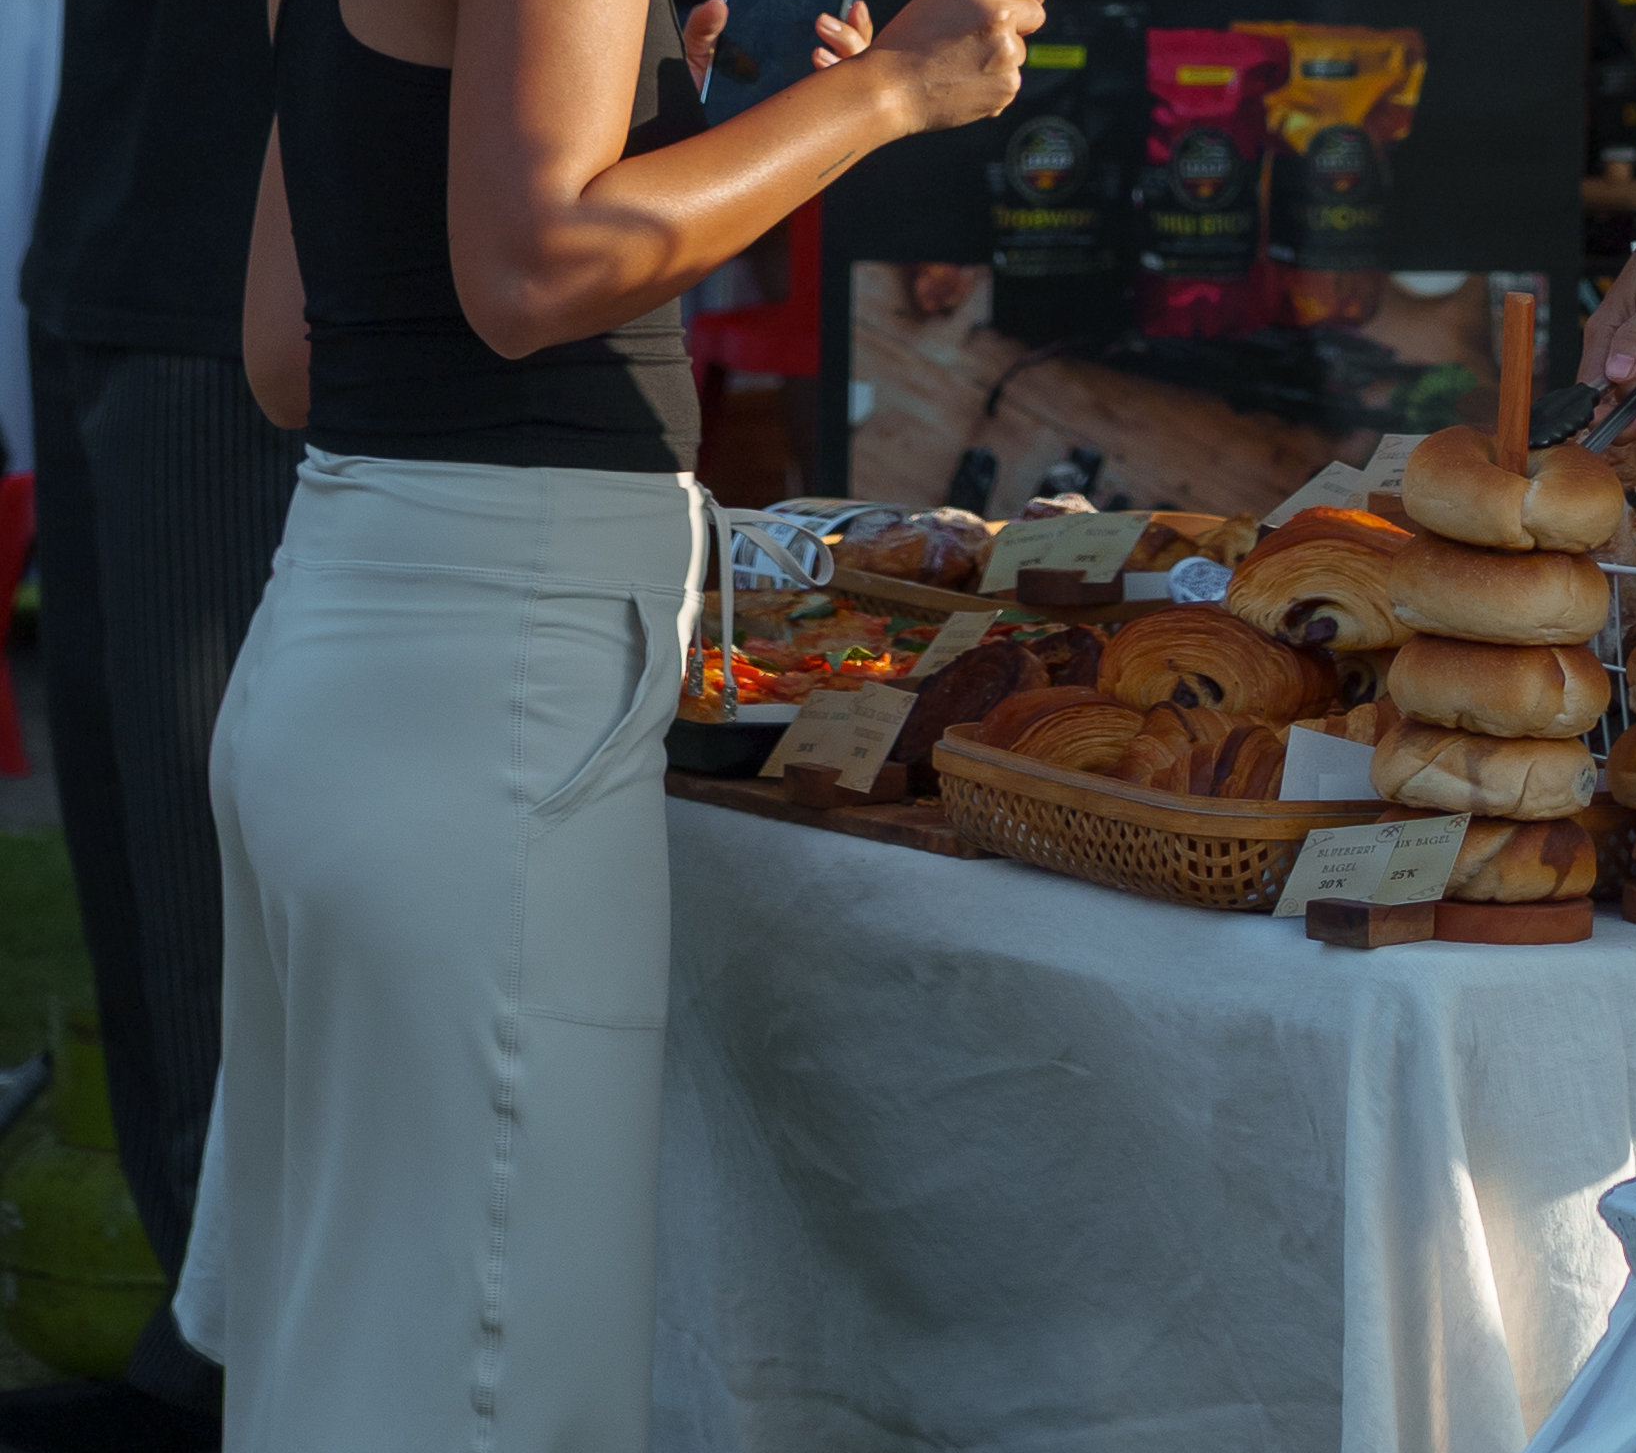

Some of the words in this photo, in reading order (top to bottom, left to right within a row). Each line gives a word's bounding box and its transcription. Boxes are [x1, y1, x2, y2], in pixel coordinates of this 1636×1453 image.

[1415, 834, 1452, 847] BAGEL
[1317, 844, 1378, 858] BLUEBERRY
[1321, 861, 1358, 874] BAGEL
